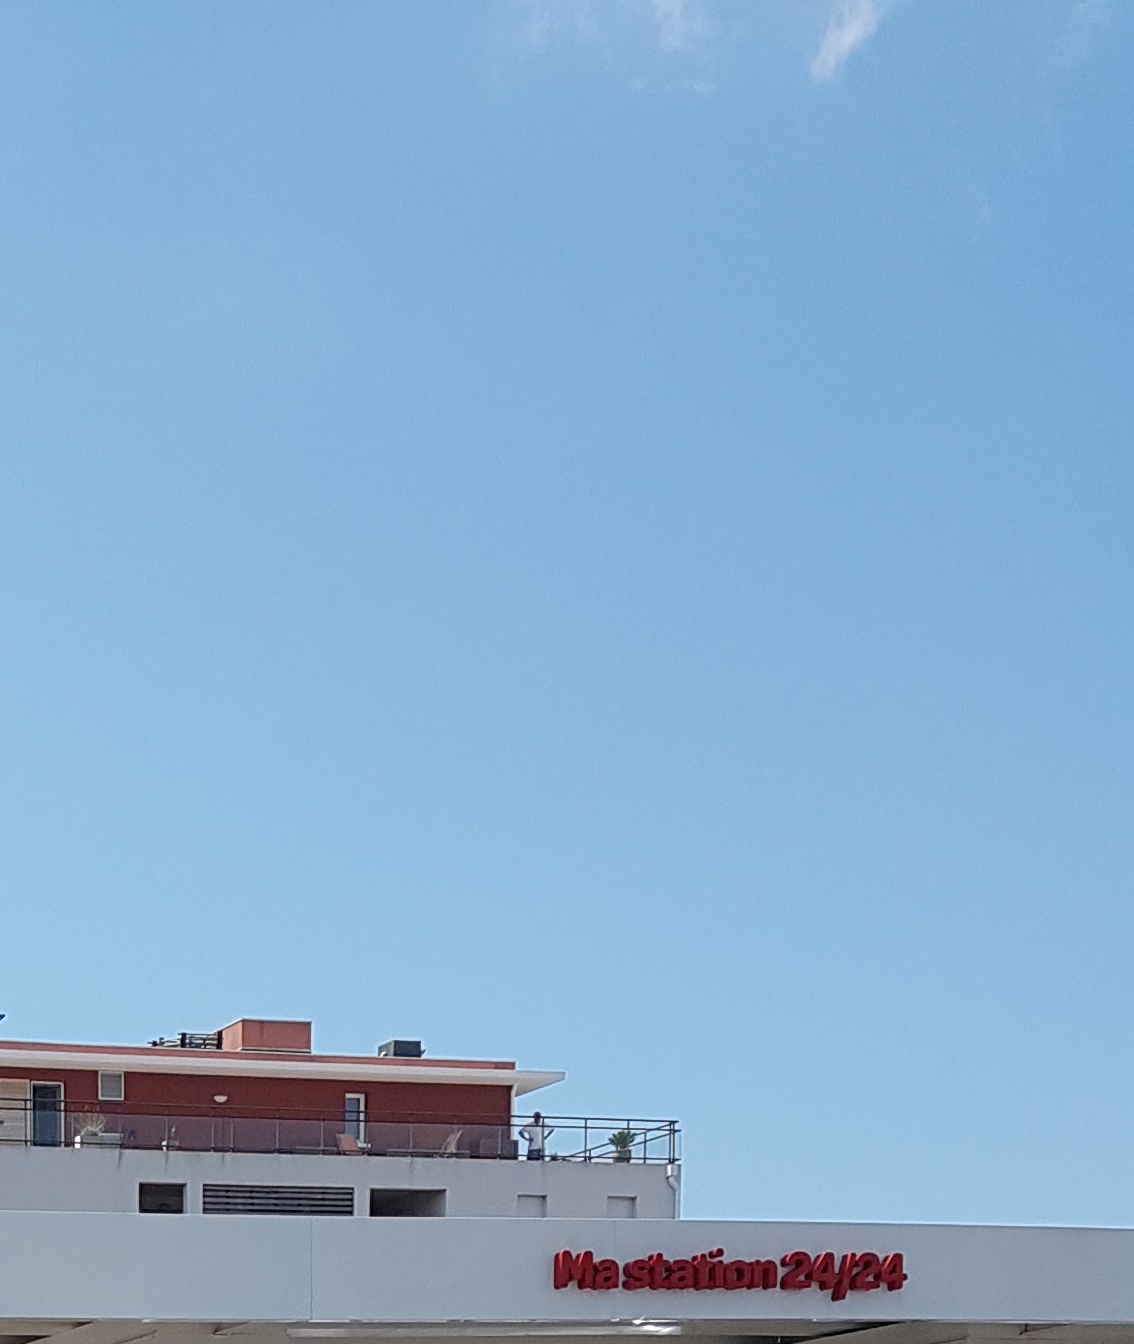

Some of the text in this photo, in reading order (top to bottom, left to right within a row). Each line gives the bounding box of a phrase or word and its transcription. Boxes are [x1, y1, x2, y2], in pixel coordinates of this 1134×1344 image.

[553, 1248, 908, 1302] Ma station 24/24
